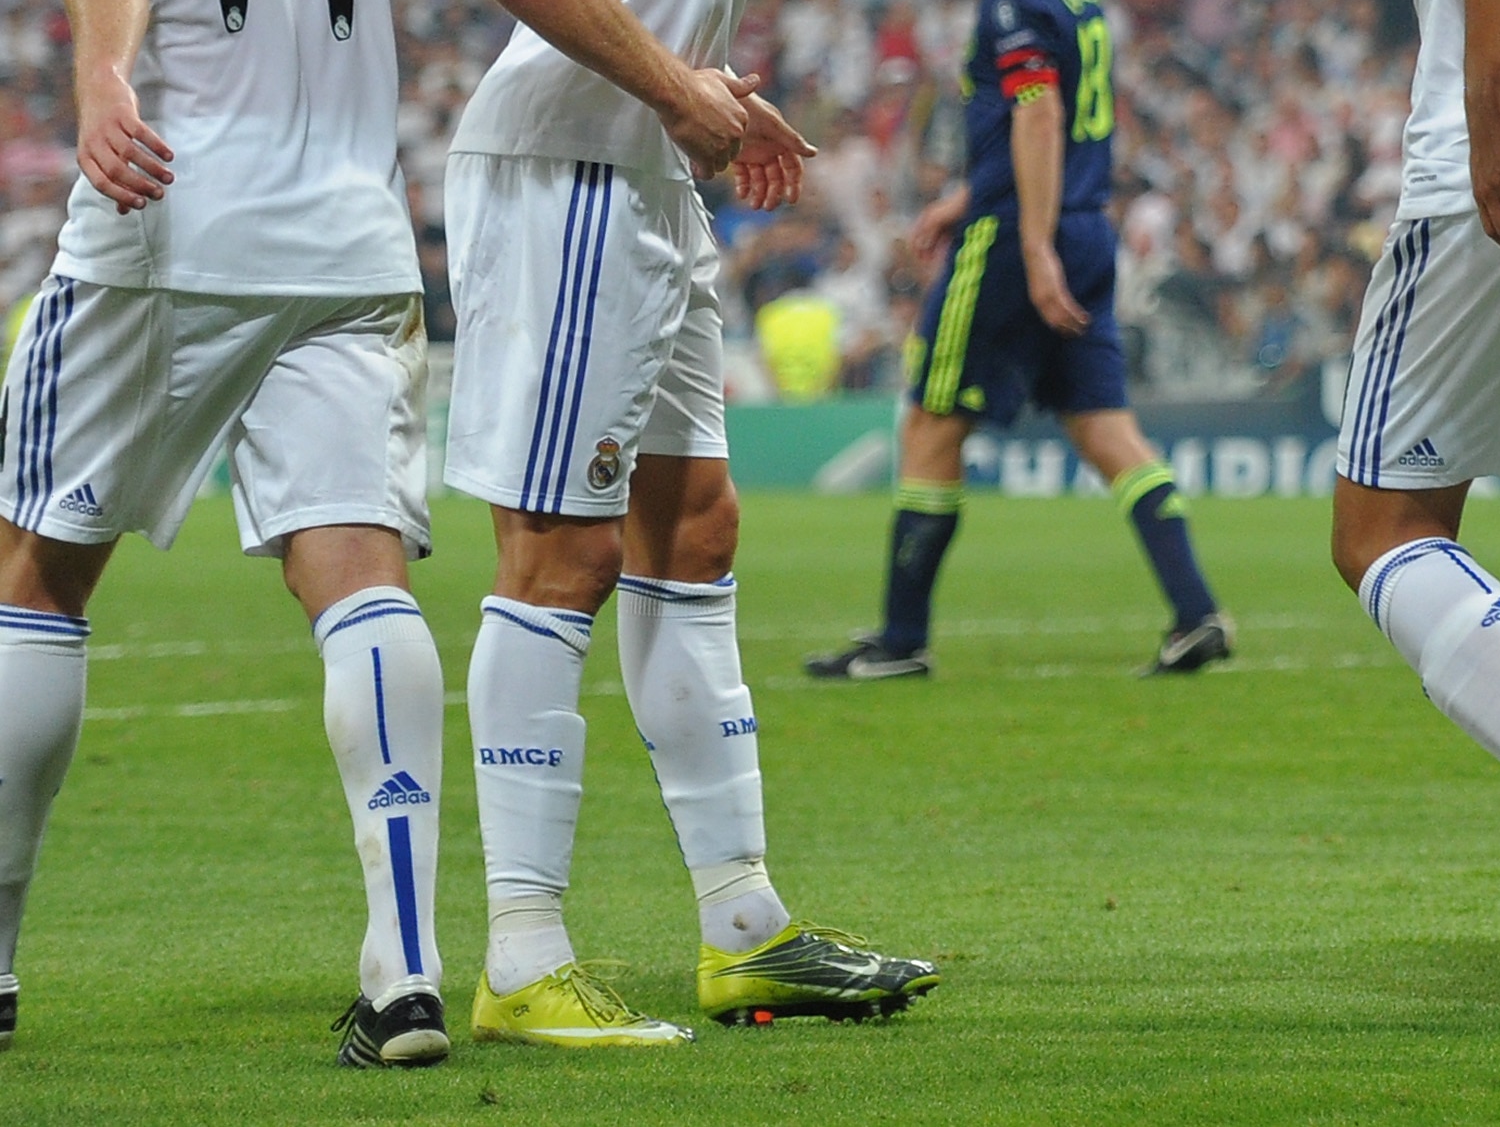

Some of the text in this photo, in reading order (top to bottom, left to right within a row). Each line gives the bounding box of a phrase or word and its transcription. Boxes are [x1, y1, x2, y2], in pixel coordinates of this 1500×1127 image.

[1398, 454, 1446, 467] adidas
[59, 498, 104, 517] adidas
[479, 747, 563, 767] RMCF
[368, 791, 431, 810] adidas
[512, 1004, 530, 1018] CR
